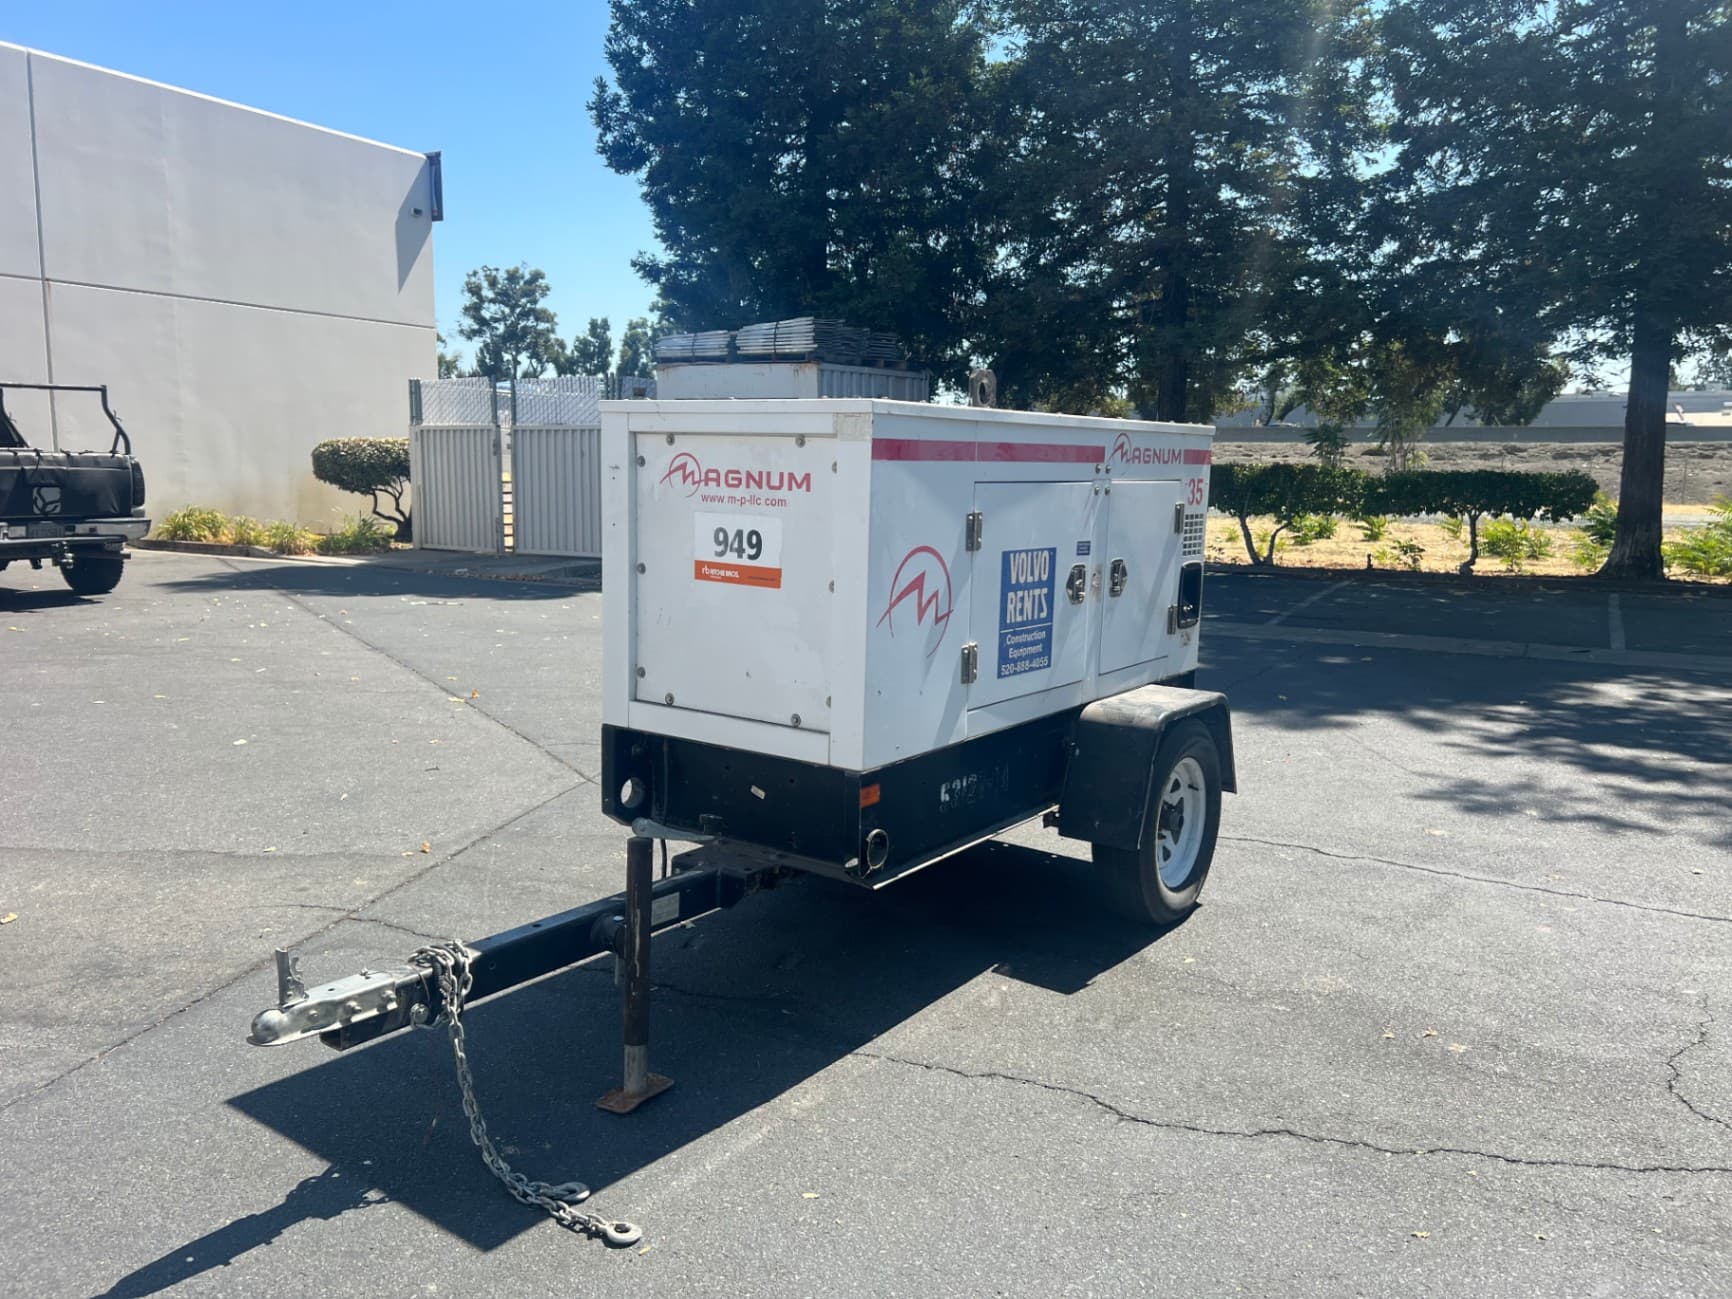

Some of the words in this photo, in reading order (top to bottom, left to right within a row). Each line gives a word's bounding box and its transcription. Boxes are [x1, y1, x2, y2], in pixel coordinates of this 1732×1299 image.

[1108, 433, 1182, 467] MAGNUM
[659, 452, 812, 497] MAGNUM
[1187, 478, 1204, 505] 35
[713, 526, 763, 561] 949
[1010, 550, 1050, 584] VOLVO
[1006, 587, 1048, 624] RENTS
[1006, 631, 1046, 645] Construction
[1008, 643, 1043, 659] Equipment
